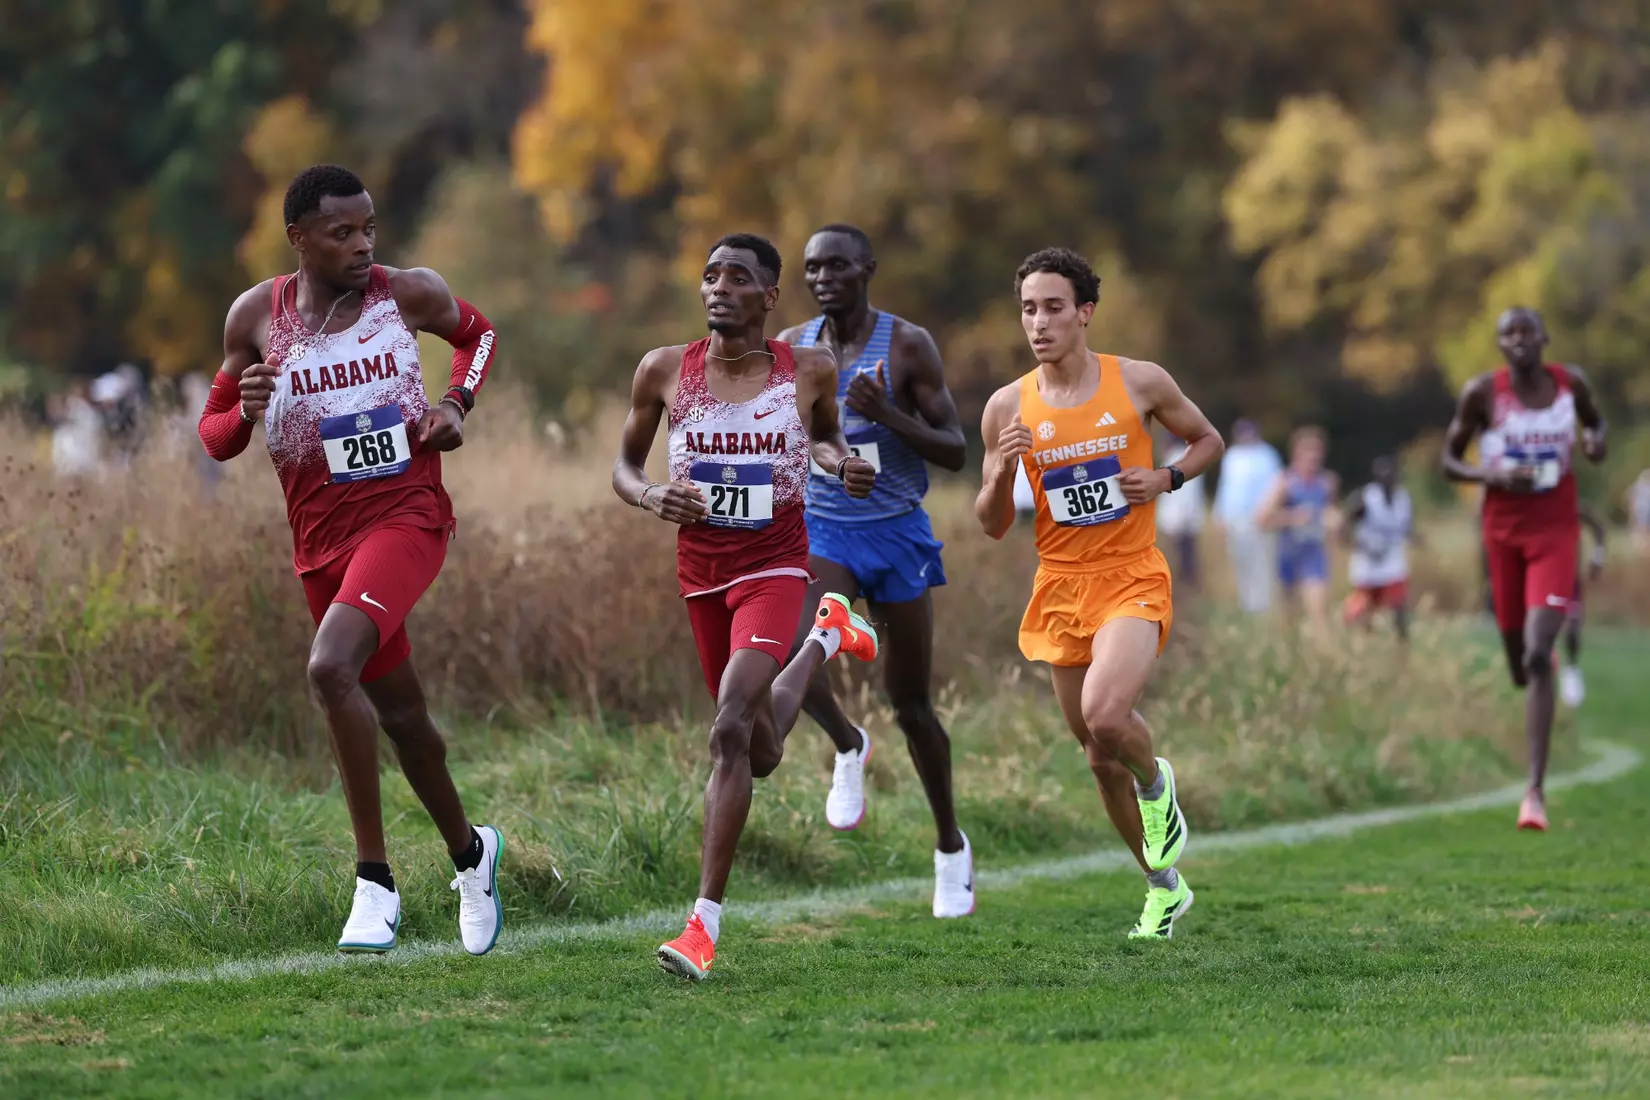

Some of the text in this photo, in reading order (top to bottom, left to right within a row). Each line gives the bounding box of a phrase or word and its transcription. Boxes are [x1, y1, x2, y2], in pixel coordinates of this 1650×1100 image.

[288, 344, 305, 360] SEC
[291, 352, 398, 396] ALABAMA
[689, 407, 704, 422] SEC
[1037, 422, 1055, 439] SEC
[343, 430, 396, 469] 268
[686, 431, 786, 455] ALABAMA
[1032, 434, 1128, 466] TENNESSEE
[711, 485, 749, 518] 271
[1063, 480, 1113, 517] 362
